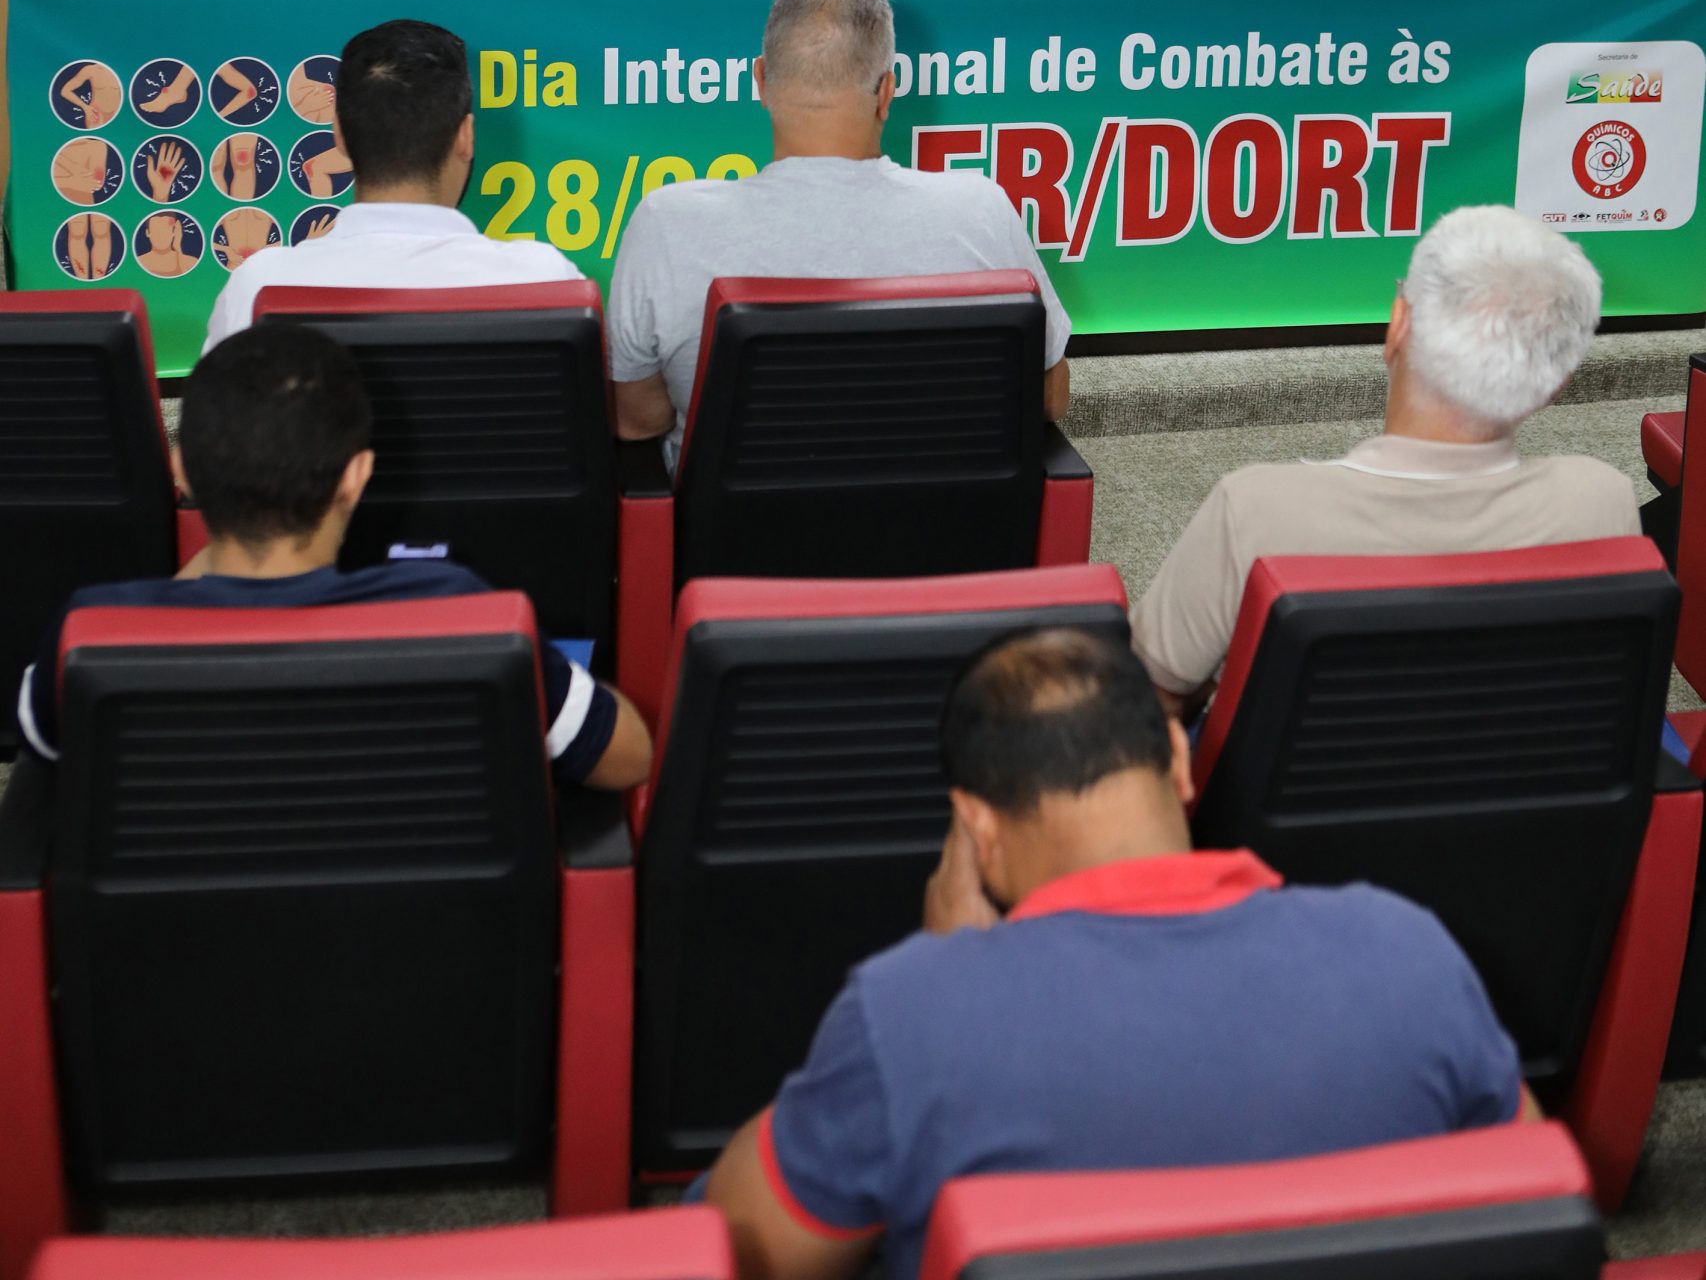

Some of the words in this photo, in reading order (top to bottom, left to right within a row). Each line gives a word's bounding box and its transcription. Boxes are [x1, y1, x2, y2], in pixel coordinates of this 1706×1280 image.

[479, 48, 578, 109] Dia
[1029, 35, 1097, 93] de
[1119, 31, 1368, 91] Combate
[1387, 28, 1452, 85] às
[1565, 72, 1661, 104] Saúde
[1586, 123, 1635, 143] QUÍMICOS
[480, 153, 758, 260] 28/
[1542, 214, 1566, 222] CUT
